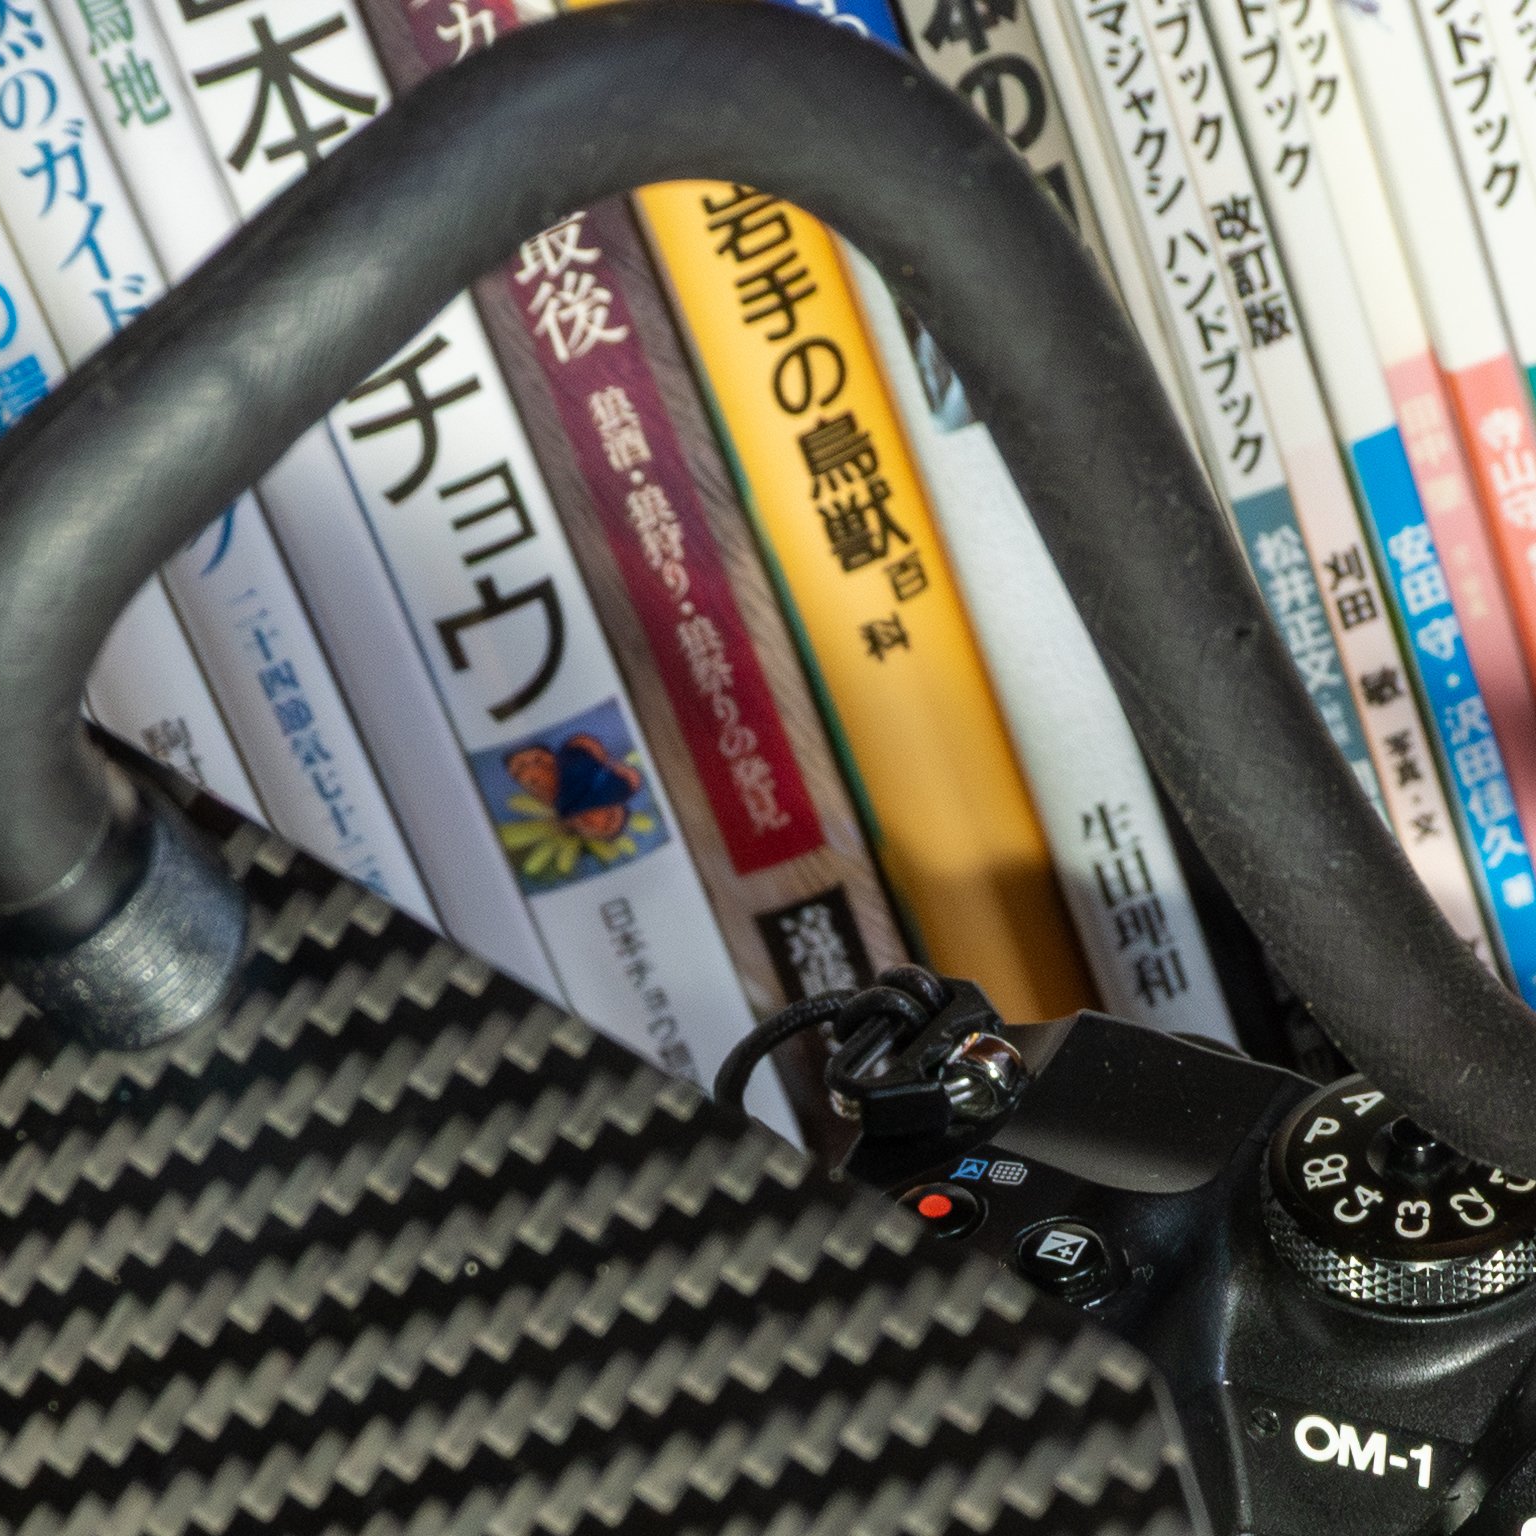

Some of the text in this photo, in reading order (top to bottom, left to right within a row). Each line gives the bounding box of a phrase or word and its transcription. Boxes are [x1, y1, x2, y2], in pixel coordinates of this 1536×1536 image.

[1436, 0, 1520, 207] ドブック
[1213, 195, 1291, 348] 改訂版
[1164, 228, 1264, 474] ハンドブック
[1342, 1088, 1385, 1117] A
[1303, 1116, 1342, 1144] P
[1332, 1184, 1385, 1225] C4
[1394, 1200, 1430, 1239] C3
[1450, 1187, 1496, 1228] C2
[1293, 1414, 1434, 1489] OM-1
